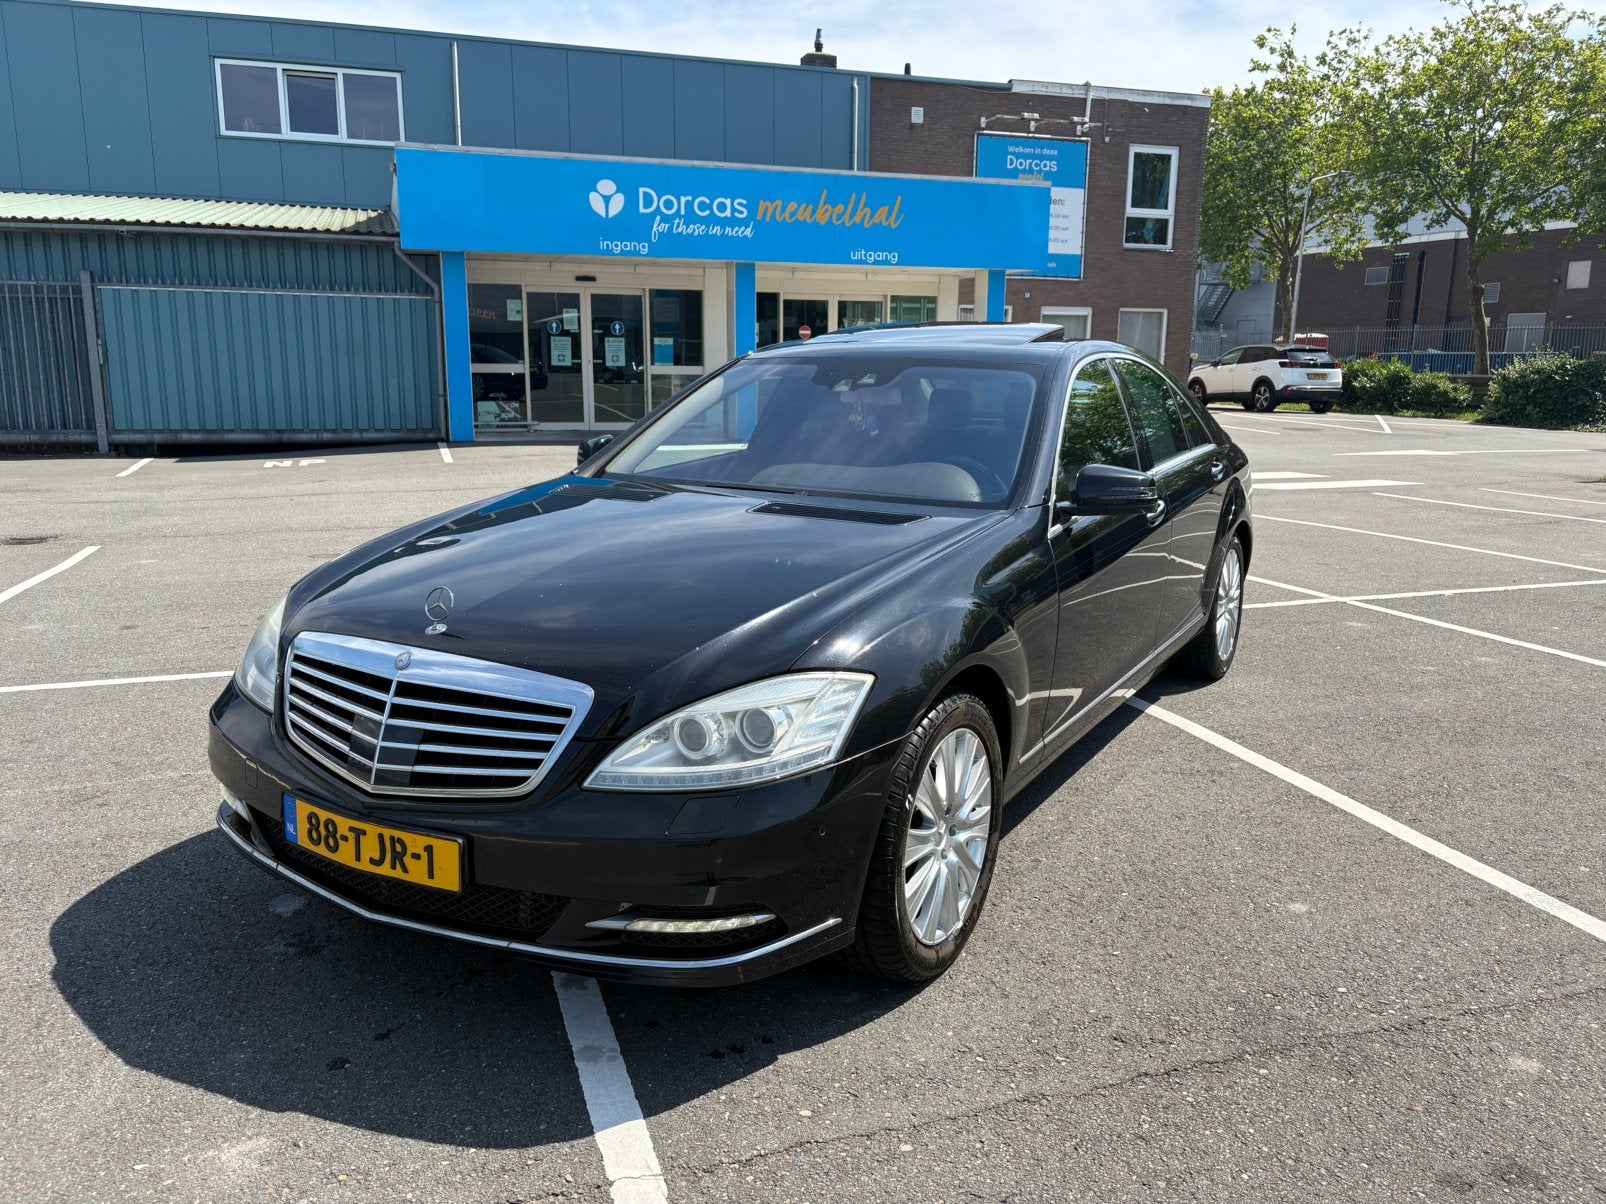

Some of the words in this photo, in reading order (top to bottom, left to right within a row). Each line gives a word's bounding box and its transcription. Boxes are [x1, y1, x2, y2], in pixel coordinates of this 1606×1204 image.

[1007, 145, 1033, 154] Welkom
[1035, 146, 1041, 154] in
[1042, 147, 1058, 156] deze
[1007, 155, 1058, 171] Dorcas
[638, 187, 748, 218] Dorcas
[757, 189, 904, 229] meubelhal
[651, 215, 670, 242] for
[673, 218, 707, 235] those
[709, 223, 723, 236] in
[725, 221, 754, 238] need
[600, 237, 648, 254] ingang
[850, 248, 898, 264] uitgang
[286, 821, 296, 835] NL
[306, 811, 435, 880] 88-TJR-1
